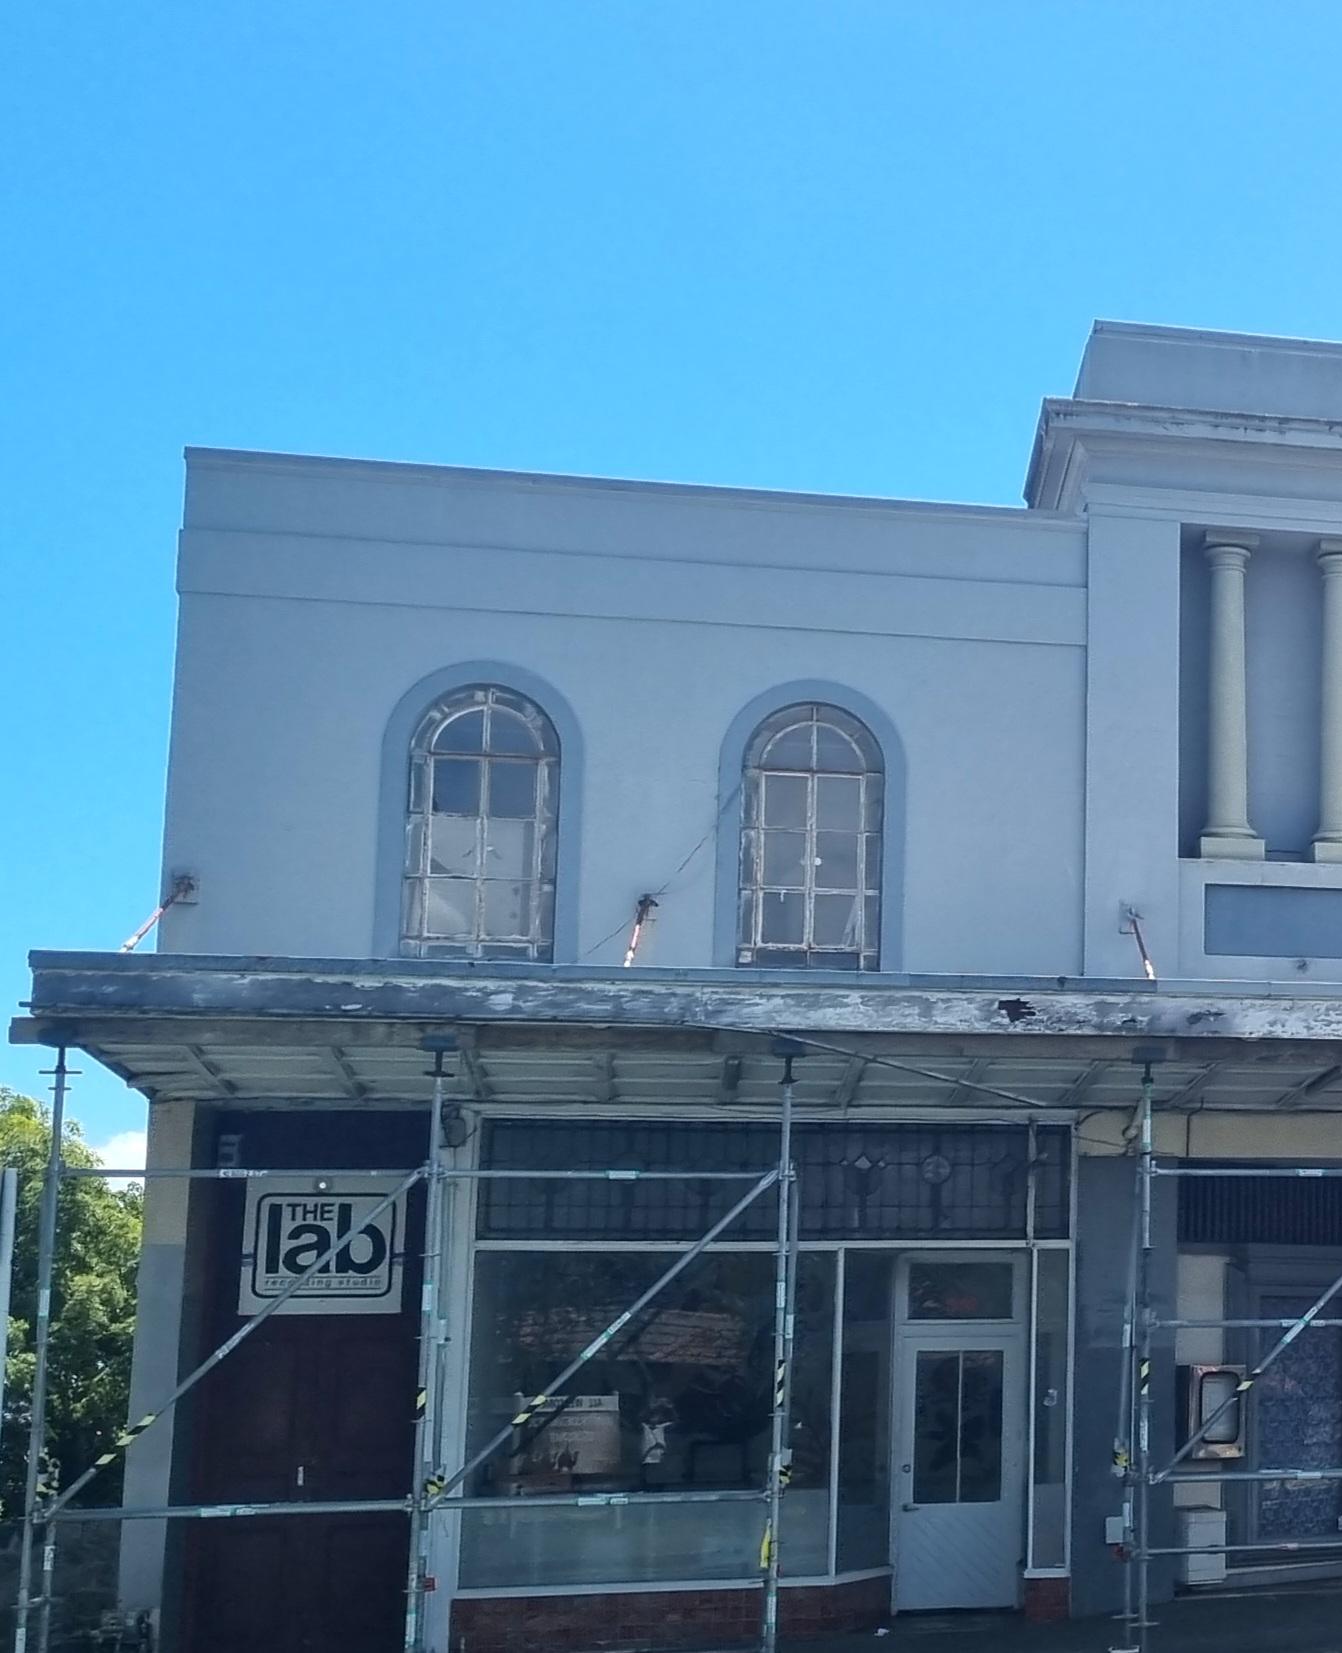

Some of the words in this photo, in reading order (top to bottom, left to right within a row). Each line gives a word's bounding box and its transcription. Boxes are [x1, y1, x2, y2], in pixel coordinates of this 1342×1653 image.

[286, 1202, 336, 1222] THE
[264, 1202, 388, 1275] lab
[337, 1278, 382, 1288] studio
